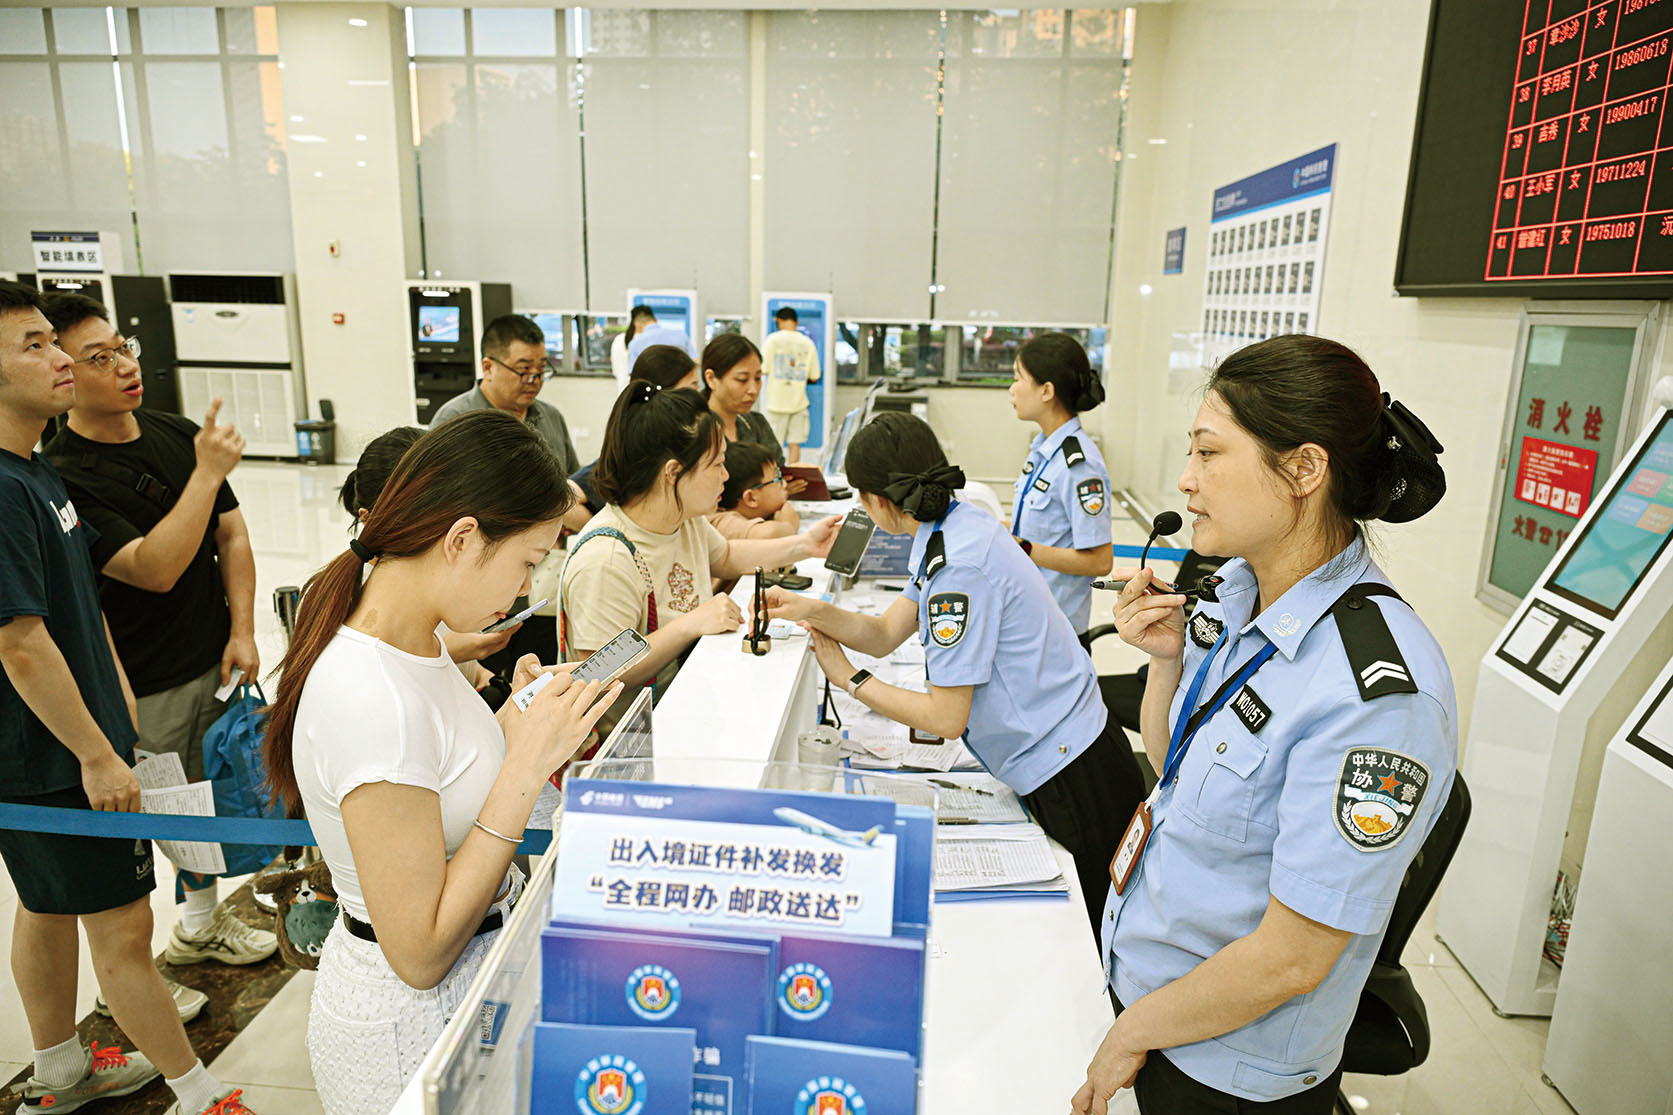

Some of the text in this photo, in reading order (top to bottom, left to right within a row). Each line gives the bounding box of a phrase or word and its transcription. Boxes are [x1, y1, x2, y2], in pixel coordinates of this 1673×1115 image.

[1594, 7, 1608, 29] 女
[1585, 61, 1600, 82] 女
[1614, 38, 1669, 70] 19860618
[1577, 113, 1591, 133] 女
[1605, 96, 1658, 124] 19900417
[1525, 174, 1556, 197] 王小军
[1568, 170, 1582, 190] 女
[1595, 160, 1647, 184] 19711224
[1558, 226, 1573, 245] 女
[1585, 221, 1636, 241] 19751018
[1527, 398, 1604, 441] 消火栓
[1351, 768, 1418, 803] 协 警
[1352, 753, 1426, 786] 中华人民共和国
[609, 838, 843, 876] 出入境证件补发换发
[591, 876, 859, 921] “全程网办 邮政送达”
